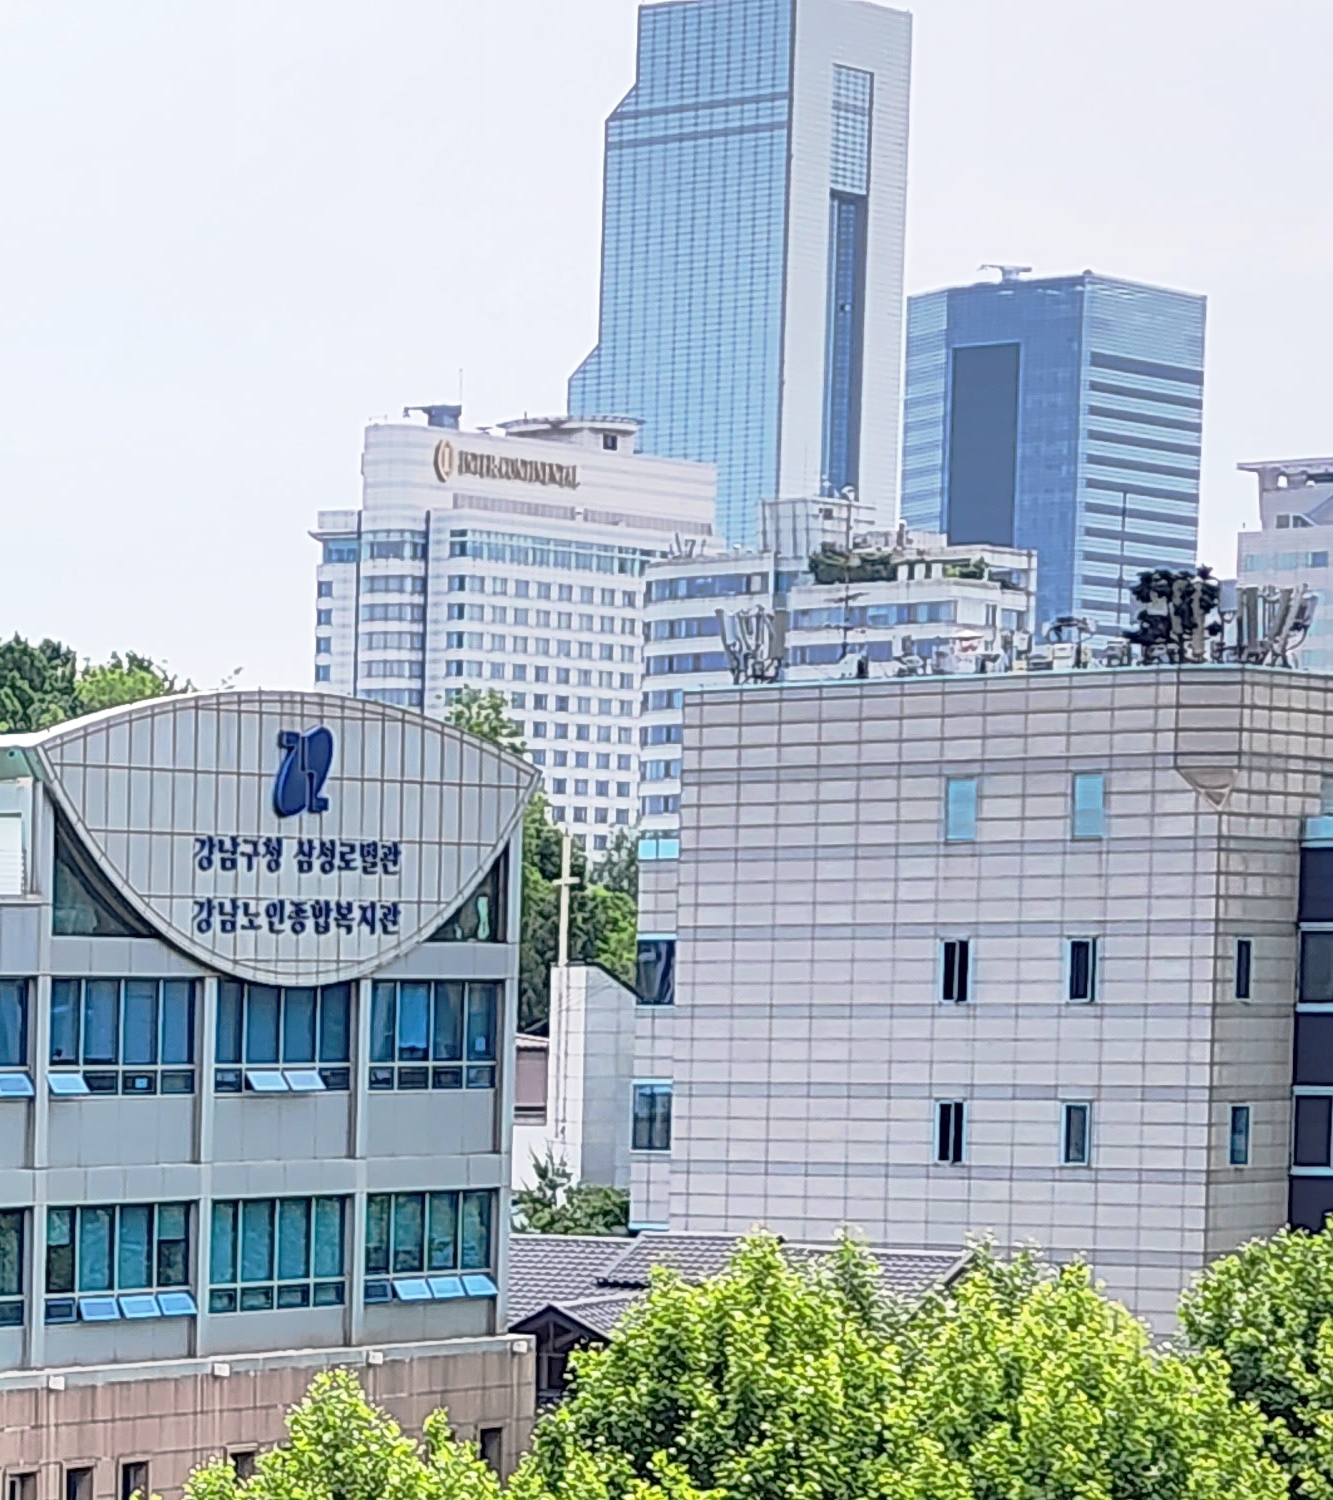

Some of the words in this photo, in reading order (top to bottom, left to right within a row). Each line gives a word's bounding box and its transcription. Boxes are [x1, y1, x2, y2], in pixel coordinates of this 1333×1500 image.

[194, 836, 282, 873] 강남구청
[293, 838, 401, 875] 삼성로별관
[193, 898, 401, 935] 강남노인종합복지관
